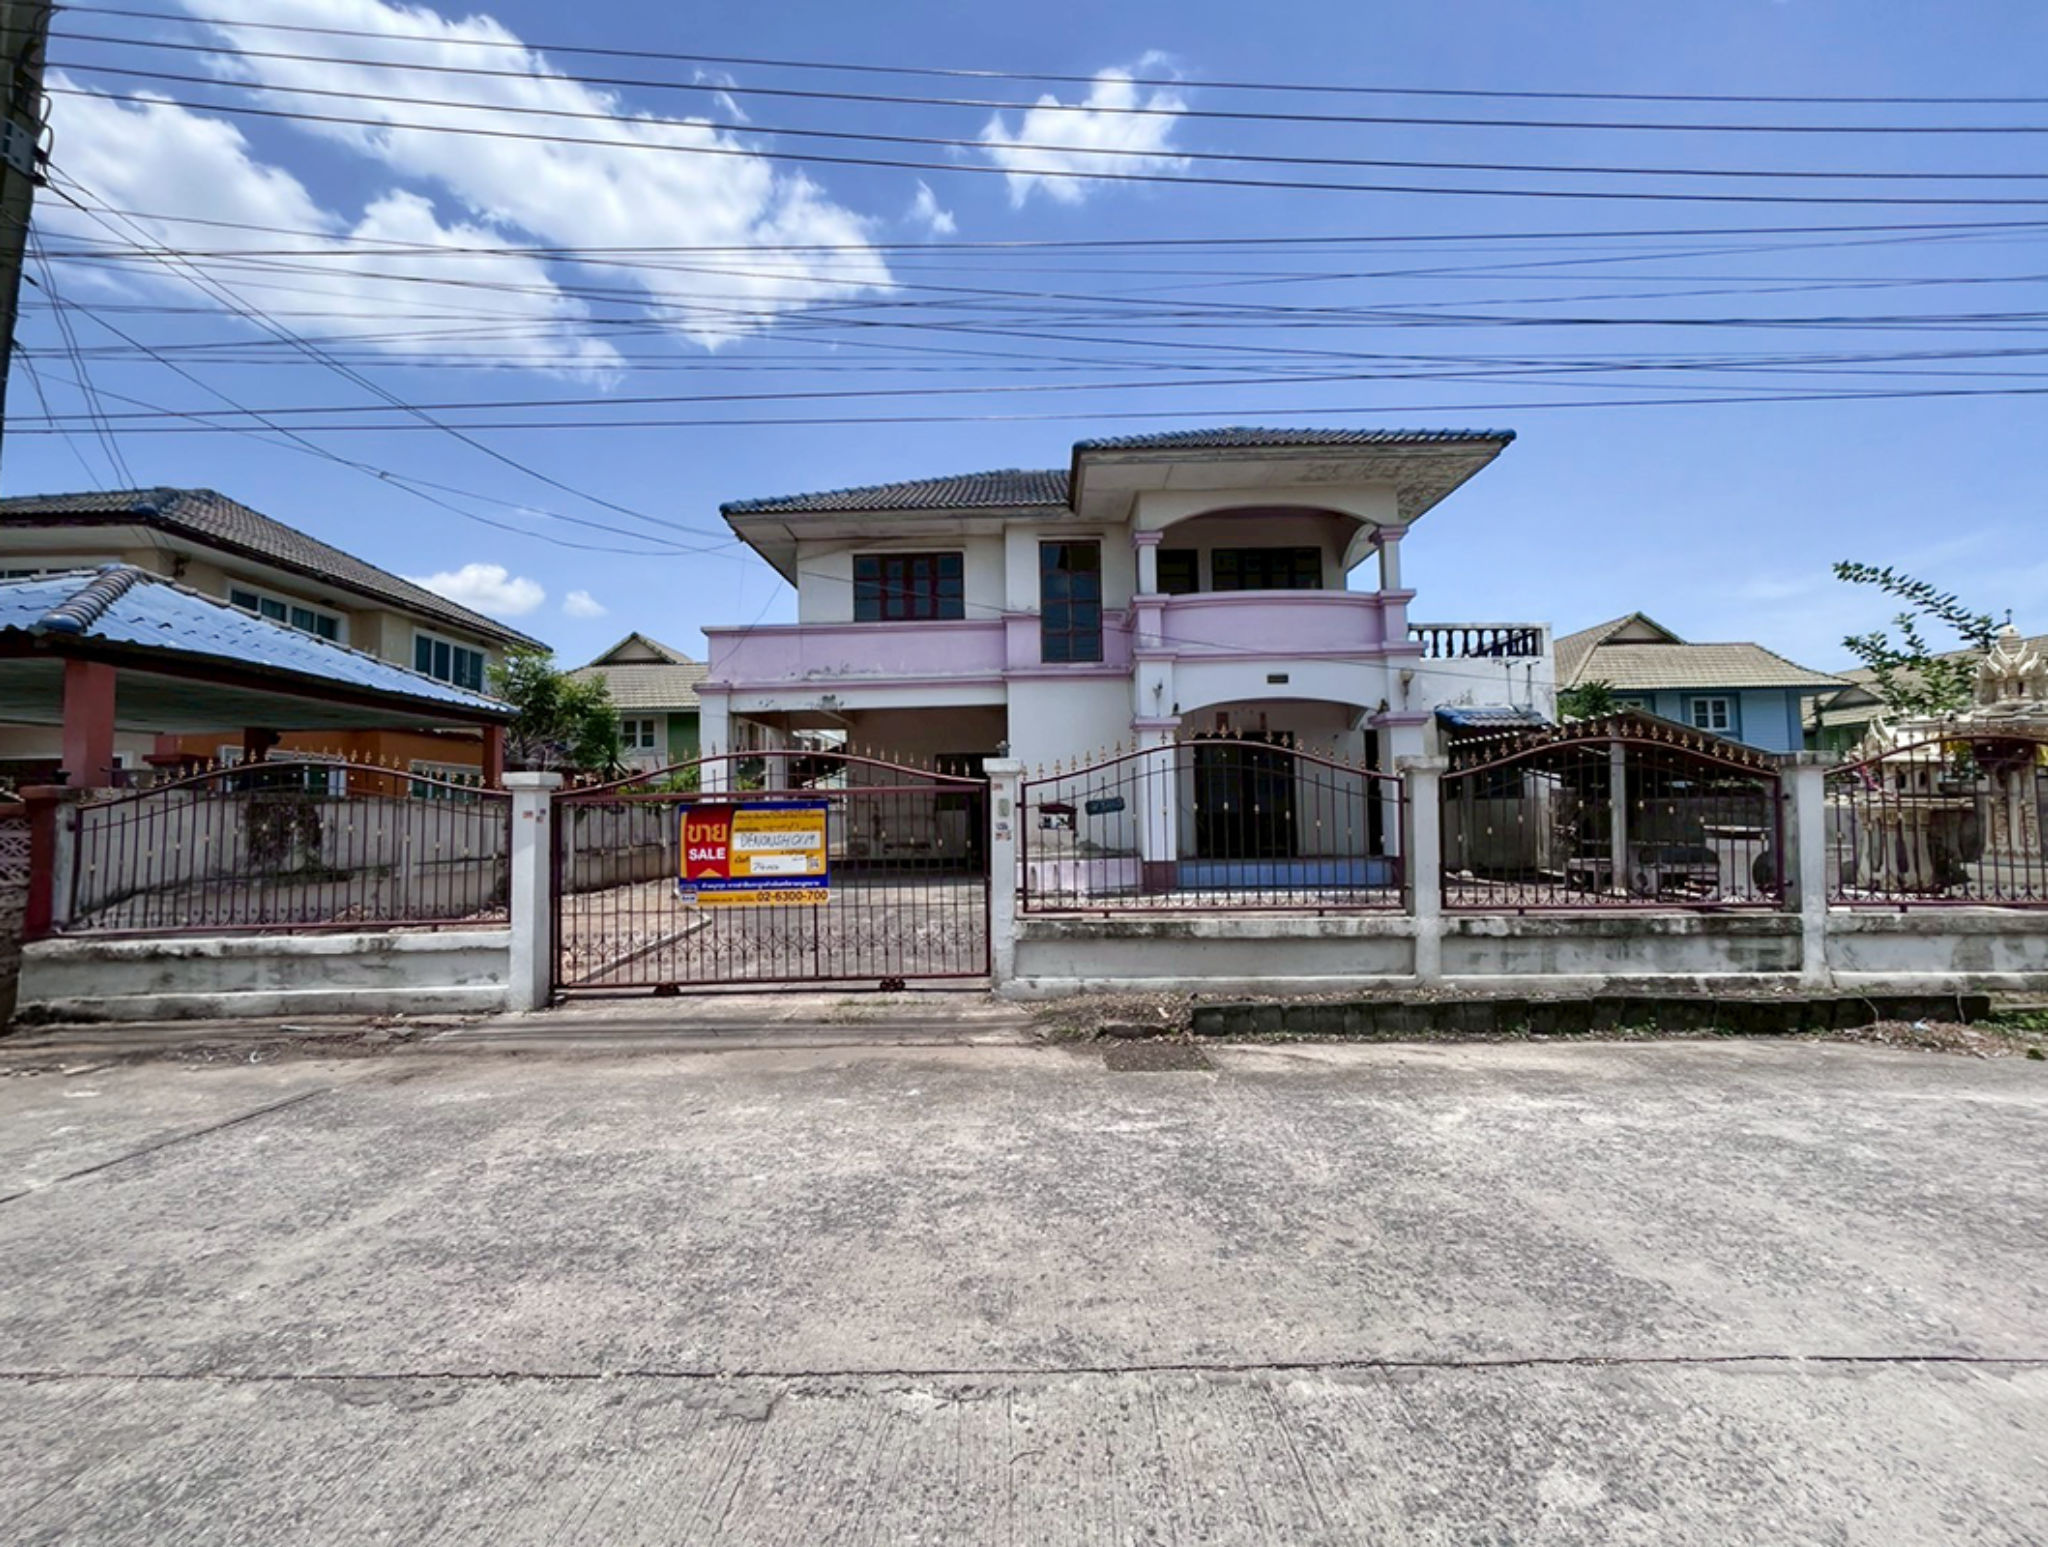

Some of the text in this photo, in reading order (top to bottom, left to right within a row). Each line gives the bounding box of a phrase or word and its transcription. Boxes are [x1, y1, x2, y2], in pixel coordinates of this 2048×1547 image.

[688, 824, 727, 843] ขาย
[688, 847, 727, 861] SALE
[755, 890, 829, 902] 02-6300-700
